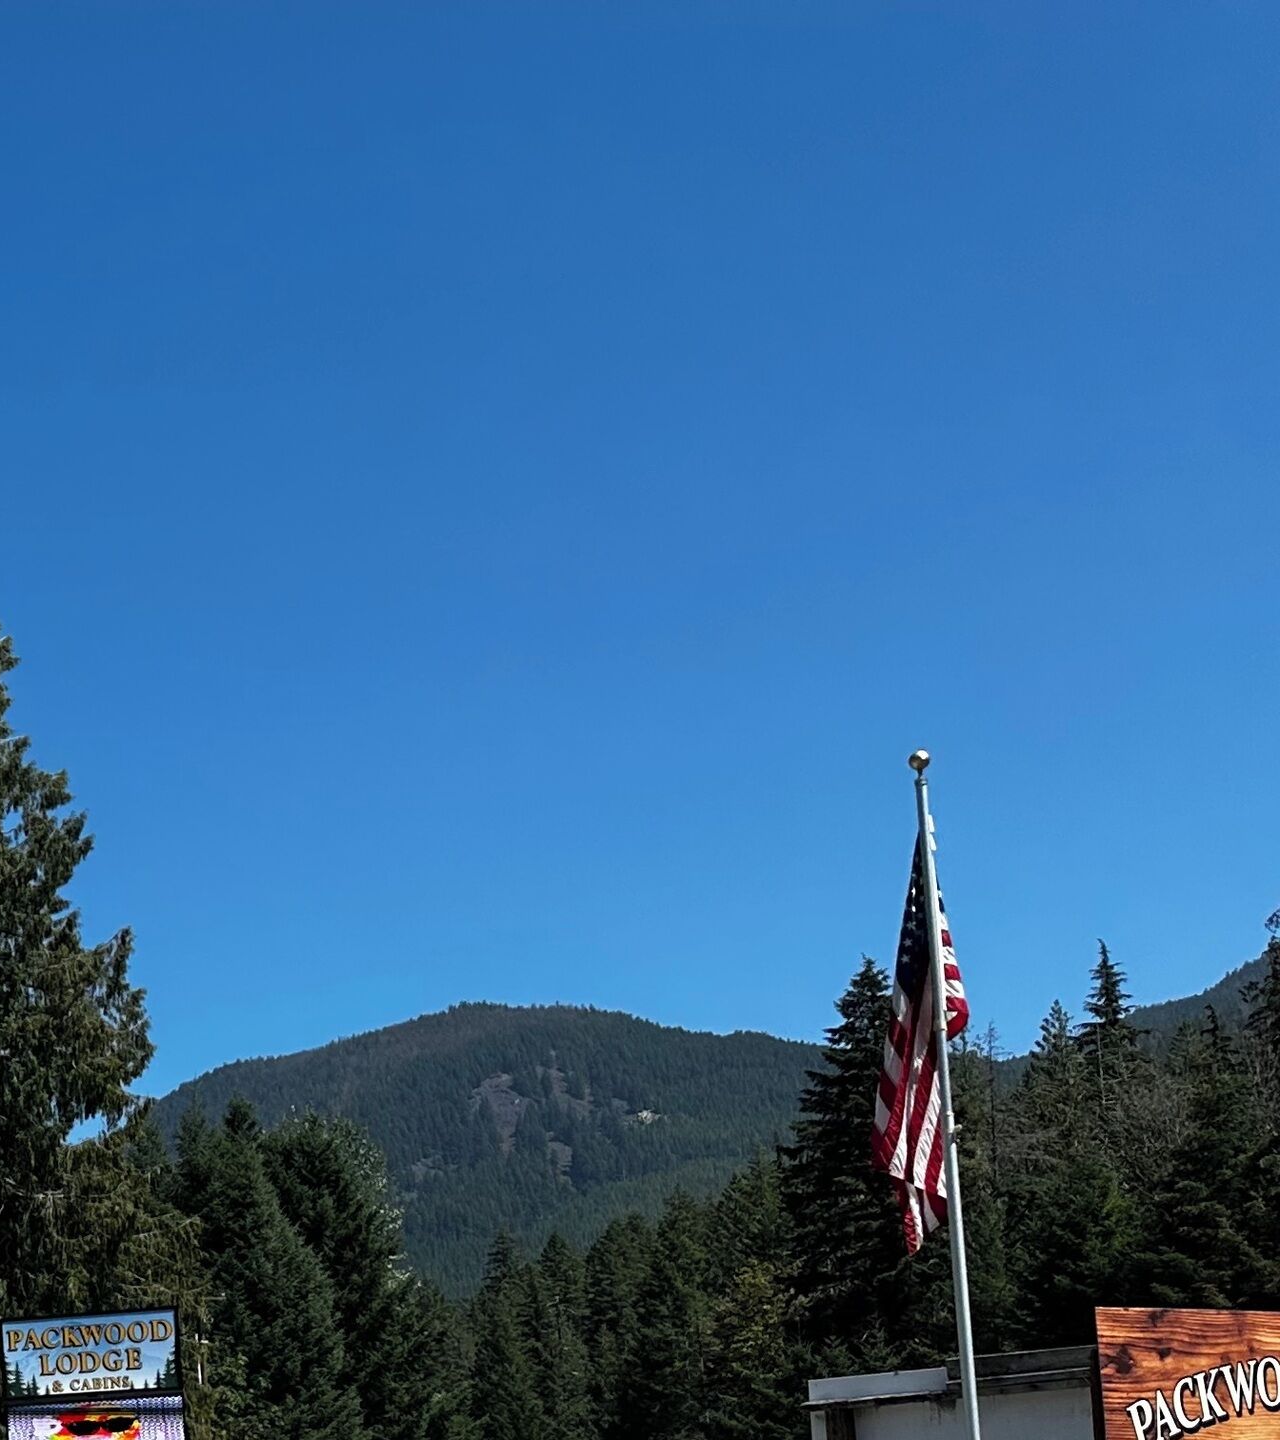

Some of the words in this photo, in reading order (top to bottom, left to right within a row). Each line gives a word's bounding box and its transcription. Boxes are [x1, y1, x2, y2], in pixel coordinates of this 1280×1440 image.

[6, 1319, 173, 1351] PACKWOOD
[40, 1347, 143, 1376] LODGE
[52, 1379, 64, 1392] &
[69, 1375, 130, 1391] CABINS
